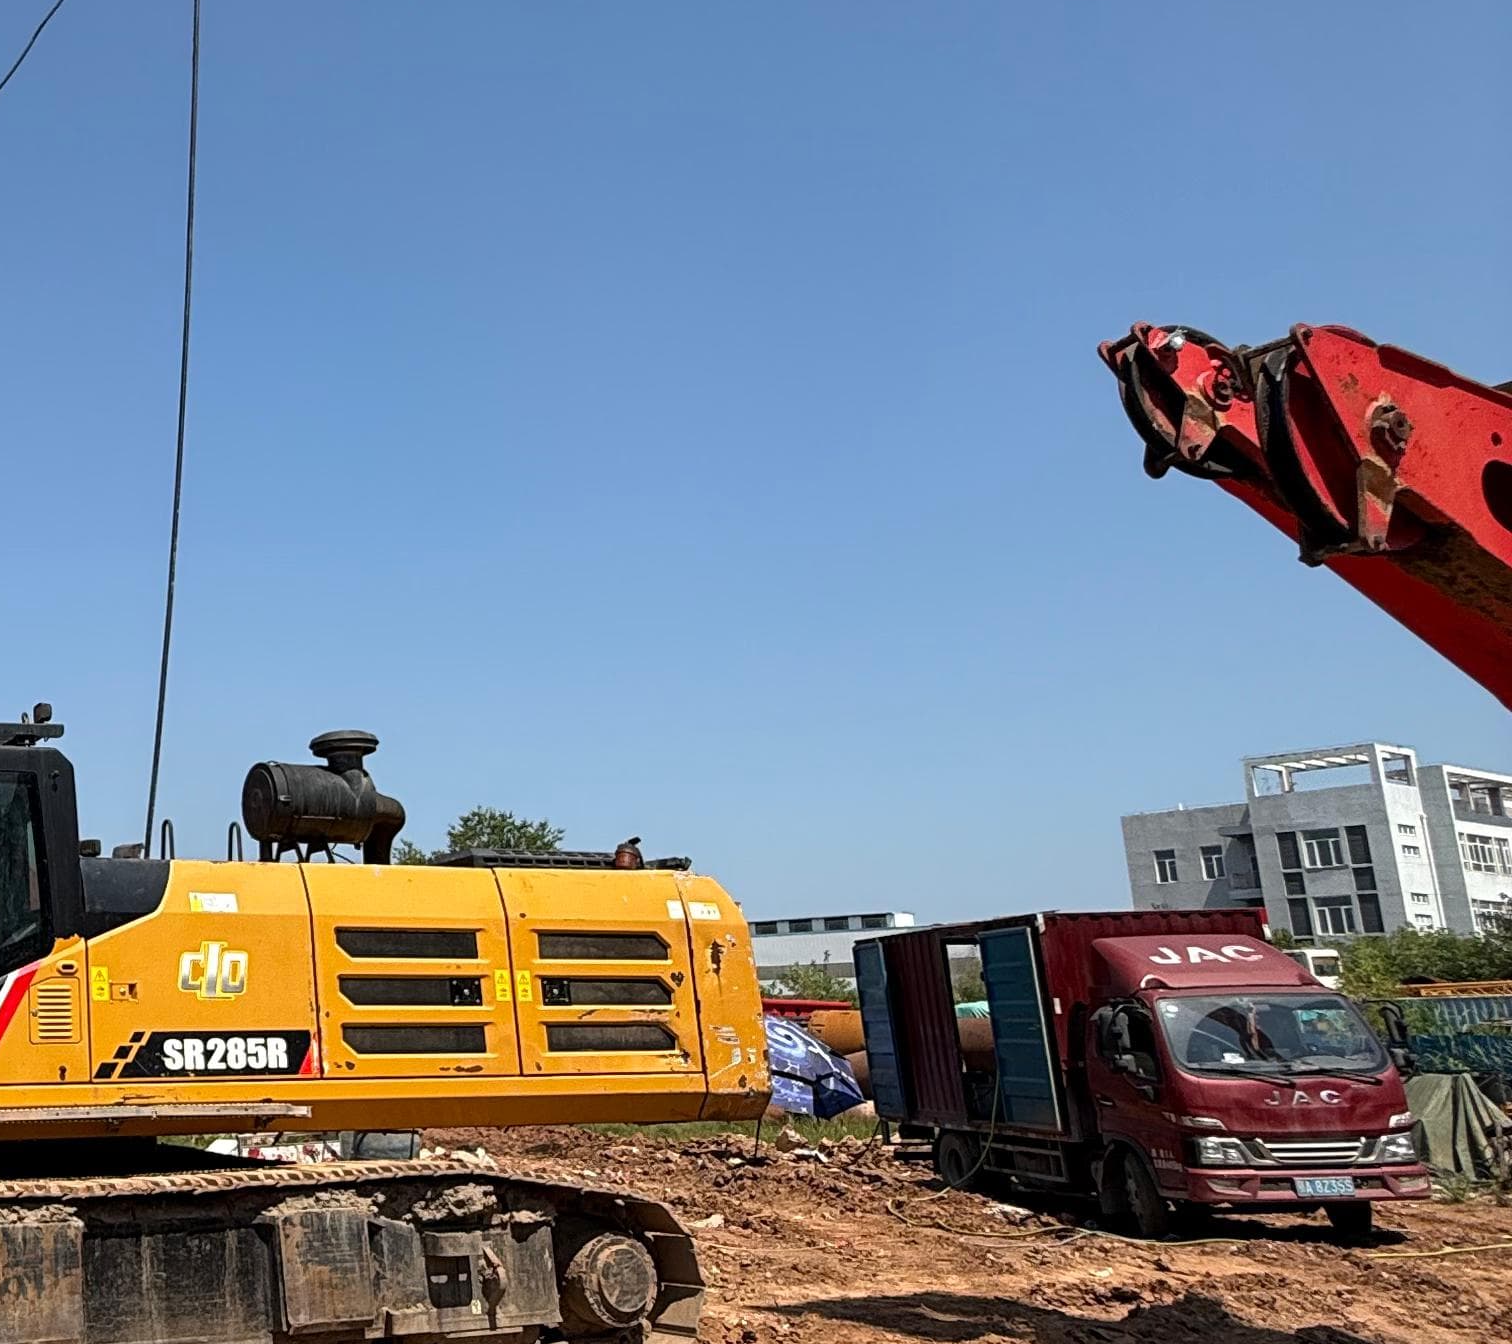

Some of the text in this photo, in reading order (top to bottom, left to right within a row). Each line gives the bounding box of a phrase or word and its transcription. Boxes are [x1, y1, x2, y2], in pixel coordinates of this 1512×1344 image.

[1148, 945, 1264, 964] JAC
[163, 1037, 289, 1071] SR285R
[1264, 1089, 1343, 1105] JAC
